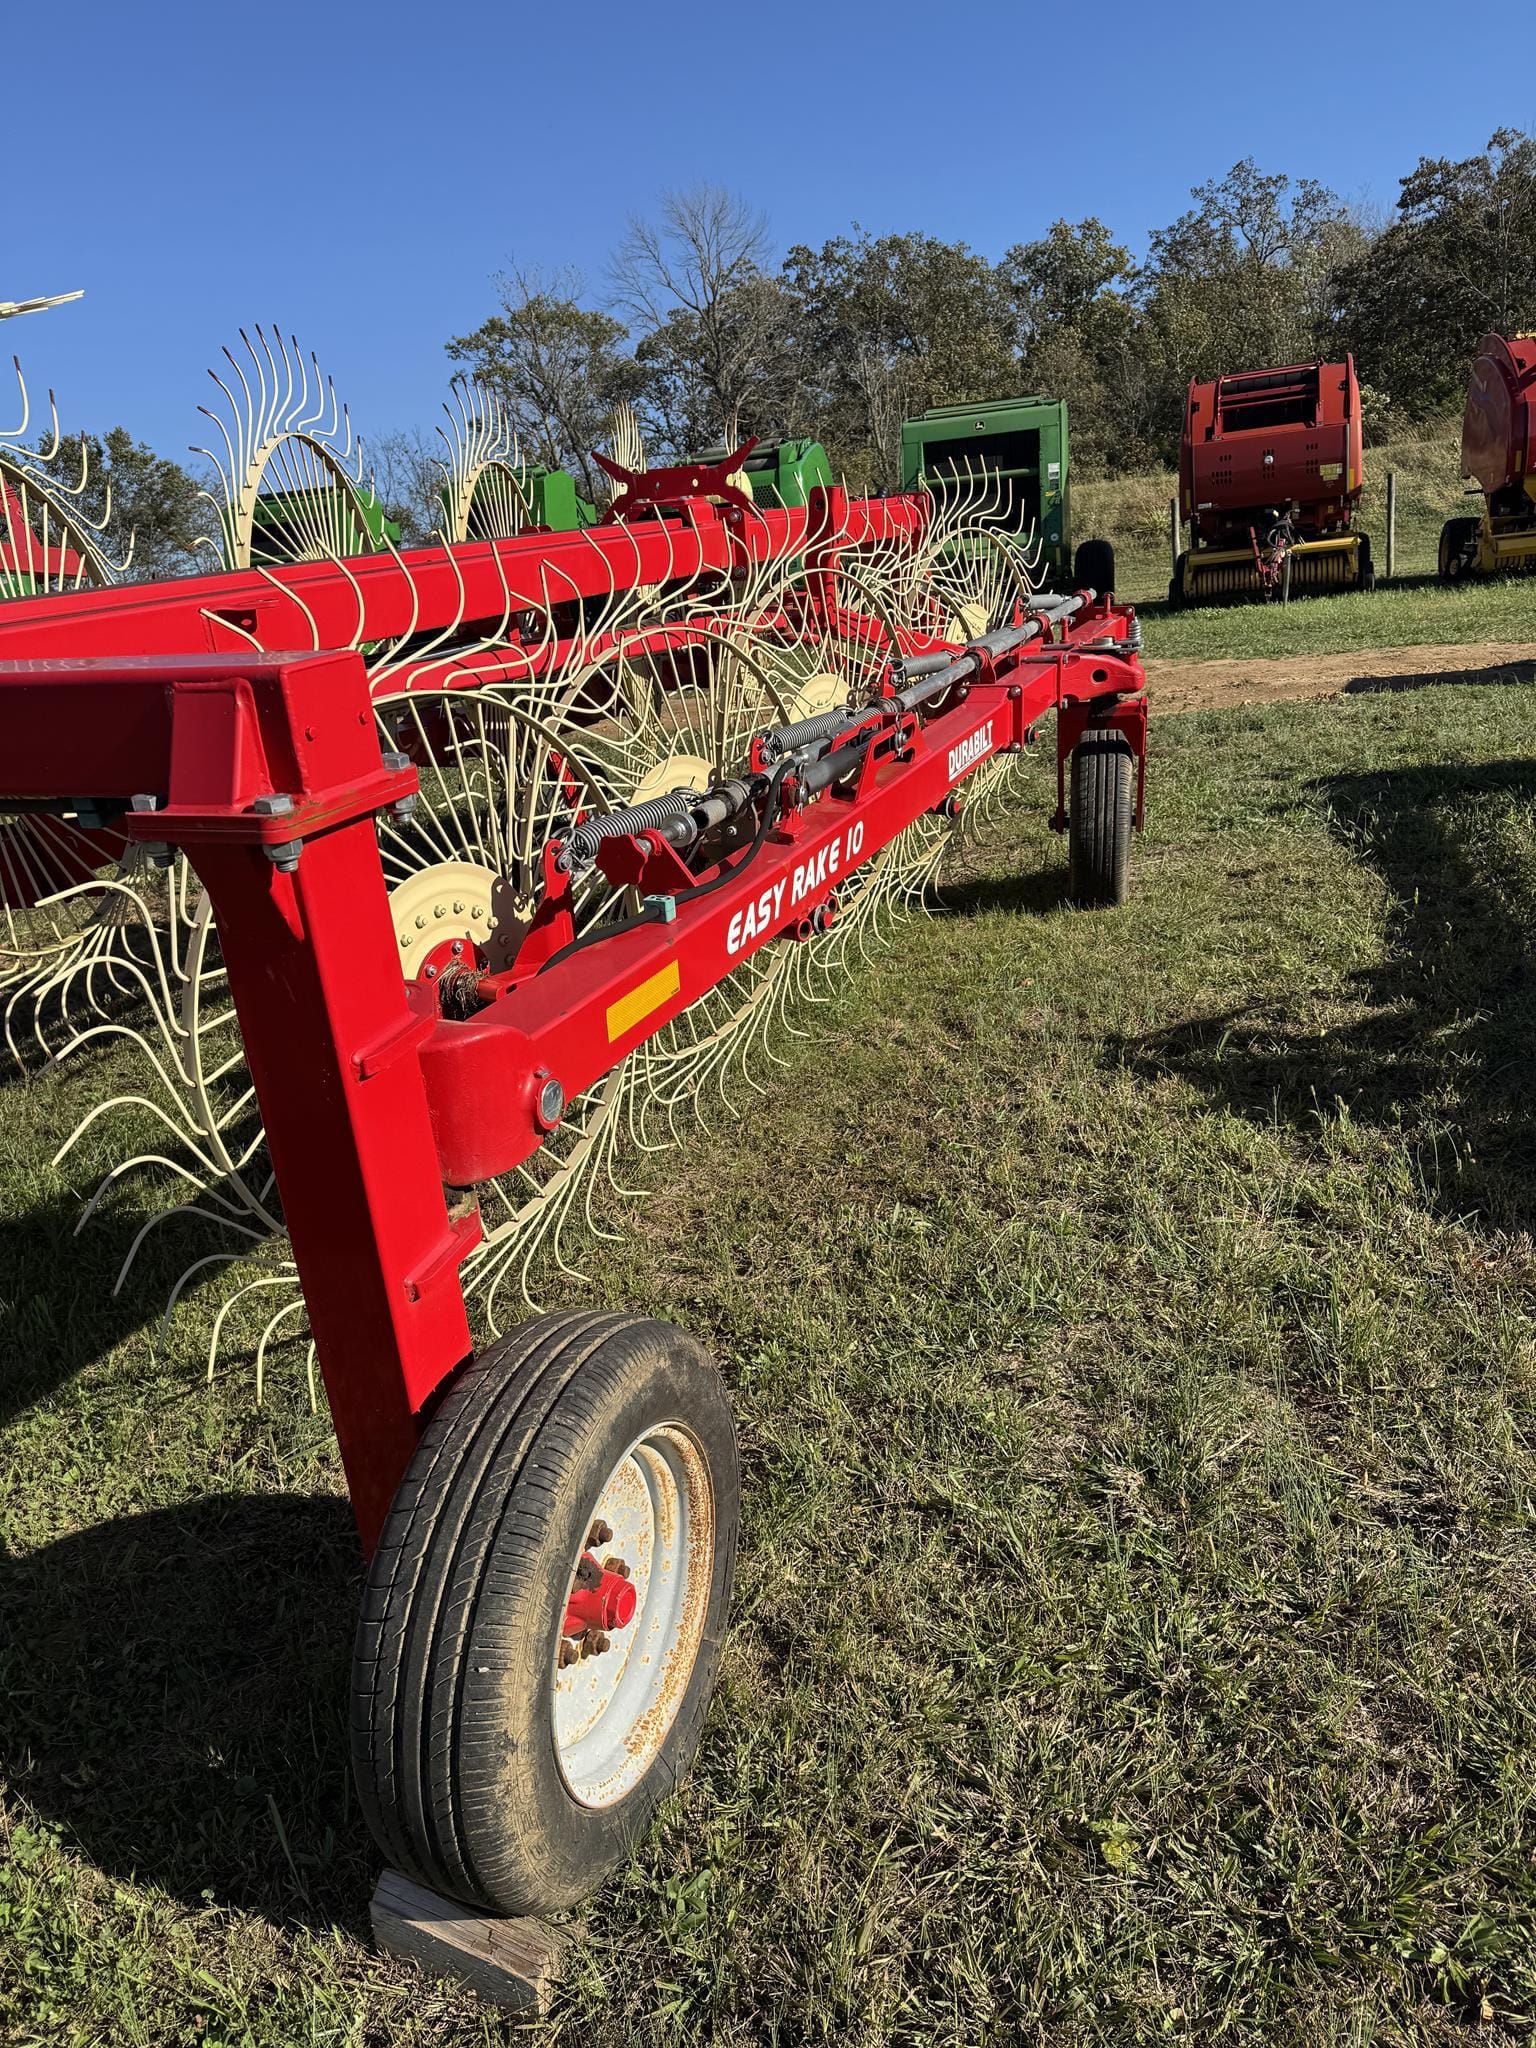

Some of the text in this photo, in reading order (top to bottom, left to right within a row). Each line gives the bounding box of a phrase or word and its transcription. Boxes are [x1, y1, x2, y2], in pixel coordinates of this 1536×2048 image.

[948, 719, 993, 778] DURABILT
[726, 820, 864, 955] EASY RAKE 10
